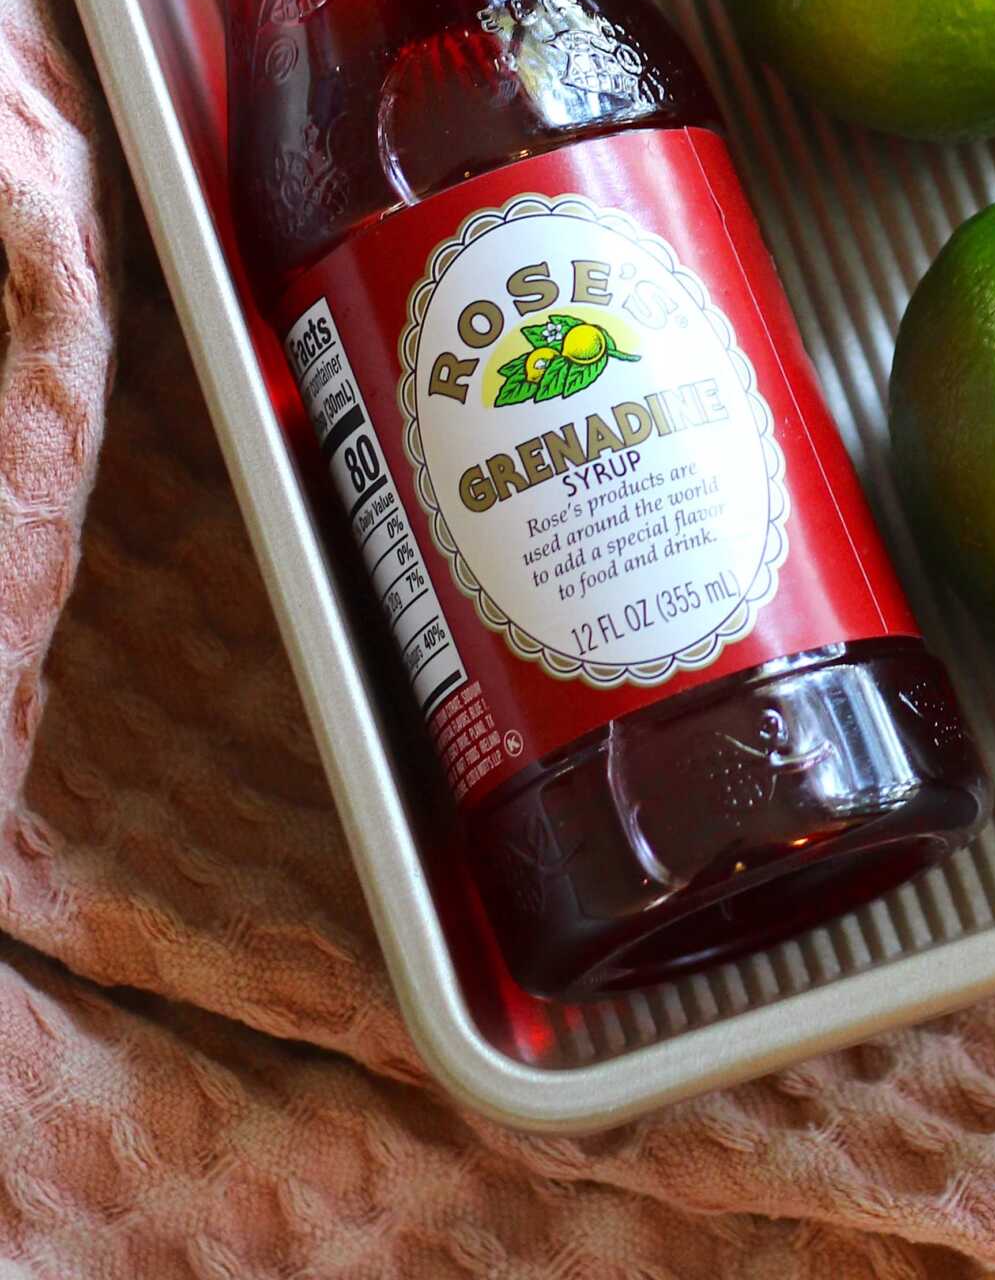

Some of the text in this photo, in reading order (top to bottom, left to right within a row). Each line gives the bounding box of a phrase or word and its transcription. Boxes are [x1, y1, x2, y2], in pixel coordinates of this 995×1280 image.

[428, 259, 680, 405] ROSE'S
[344, 434, 380, 494] 80
[458, 377, 730, 513] GRENADINE
[562, 450, 642, 498] SYRUP
[371, 491, 395, 516] Value
[386, 518, 404, 539] 0%
[522, 475, 720, 567] used around the world
[527, 461, 698, 538] Rose's products are
[396, 541, 415, 566] 0%
[532, 502, 726, 587] to add a special flavor
[558, 527, 718, 601] to food and drink.
[405, 568, 425, 593] 7%
[571, 569, 742, 656] 12 FL OZ (355 mL)
[423, 623, 446, 650] 40%
